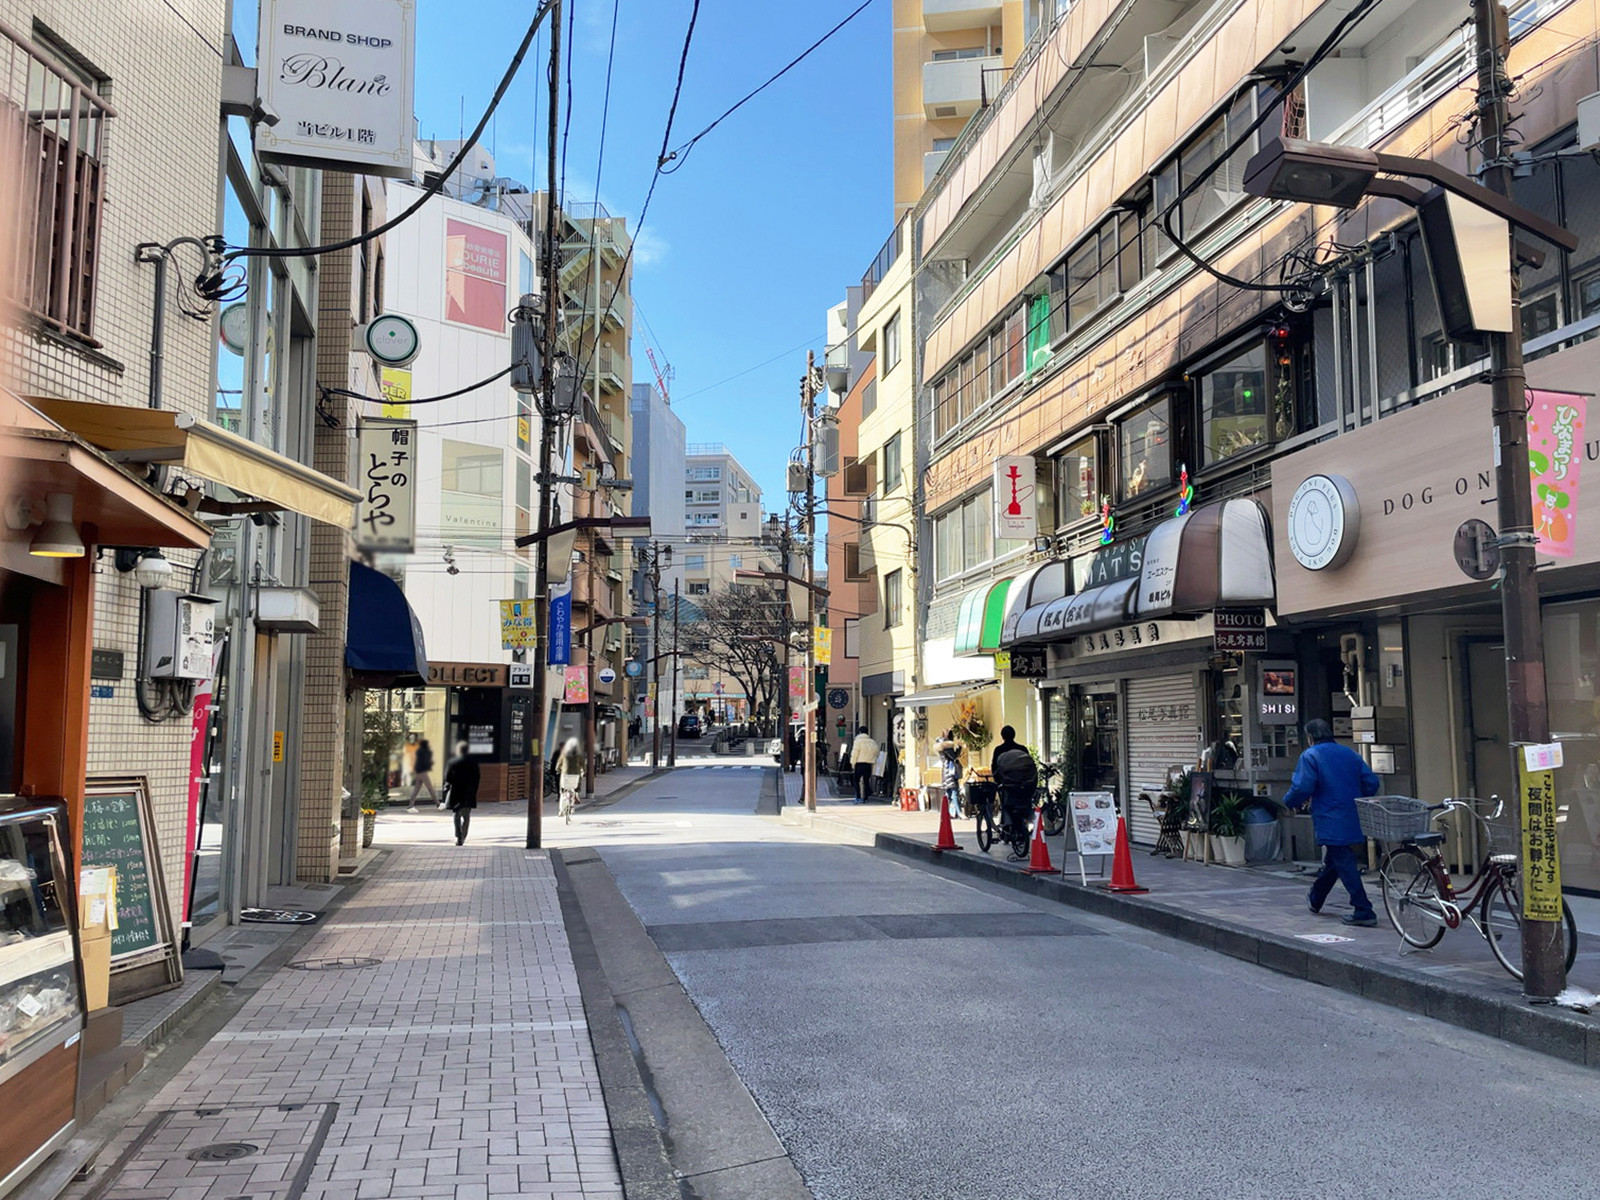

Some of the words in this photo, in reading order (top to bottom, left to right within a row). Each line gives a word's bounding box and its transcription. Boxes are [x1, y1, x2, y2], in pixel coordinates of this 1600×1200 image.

[283, 24, 341, 41] BRAND
[346, 33, 391, 48] SHOP
[280, 53, 391, 97] Blanc
[297, 120, 376, 143] 当ビル1階
[376, 335, 408, 345] clover
[391, 428, 409, 487] 帽子の
[1552, 404, 1579, 481] ひなまつり
[362, 453, 396, 535] とらや
[1383, 487, 1434, 516] DOG
[445, 515, 498, 528] Valentine
[555, 601, 565, 661] さわやか信用金庫
[1216, 614, 1264, 626] PHOTO
[513, 674, 530, 684] 買取
[1527, 787, 1544, 893] 夜間はお静かに
[1544, 774, 1556, 884] ここは住宅地です
